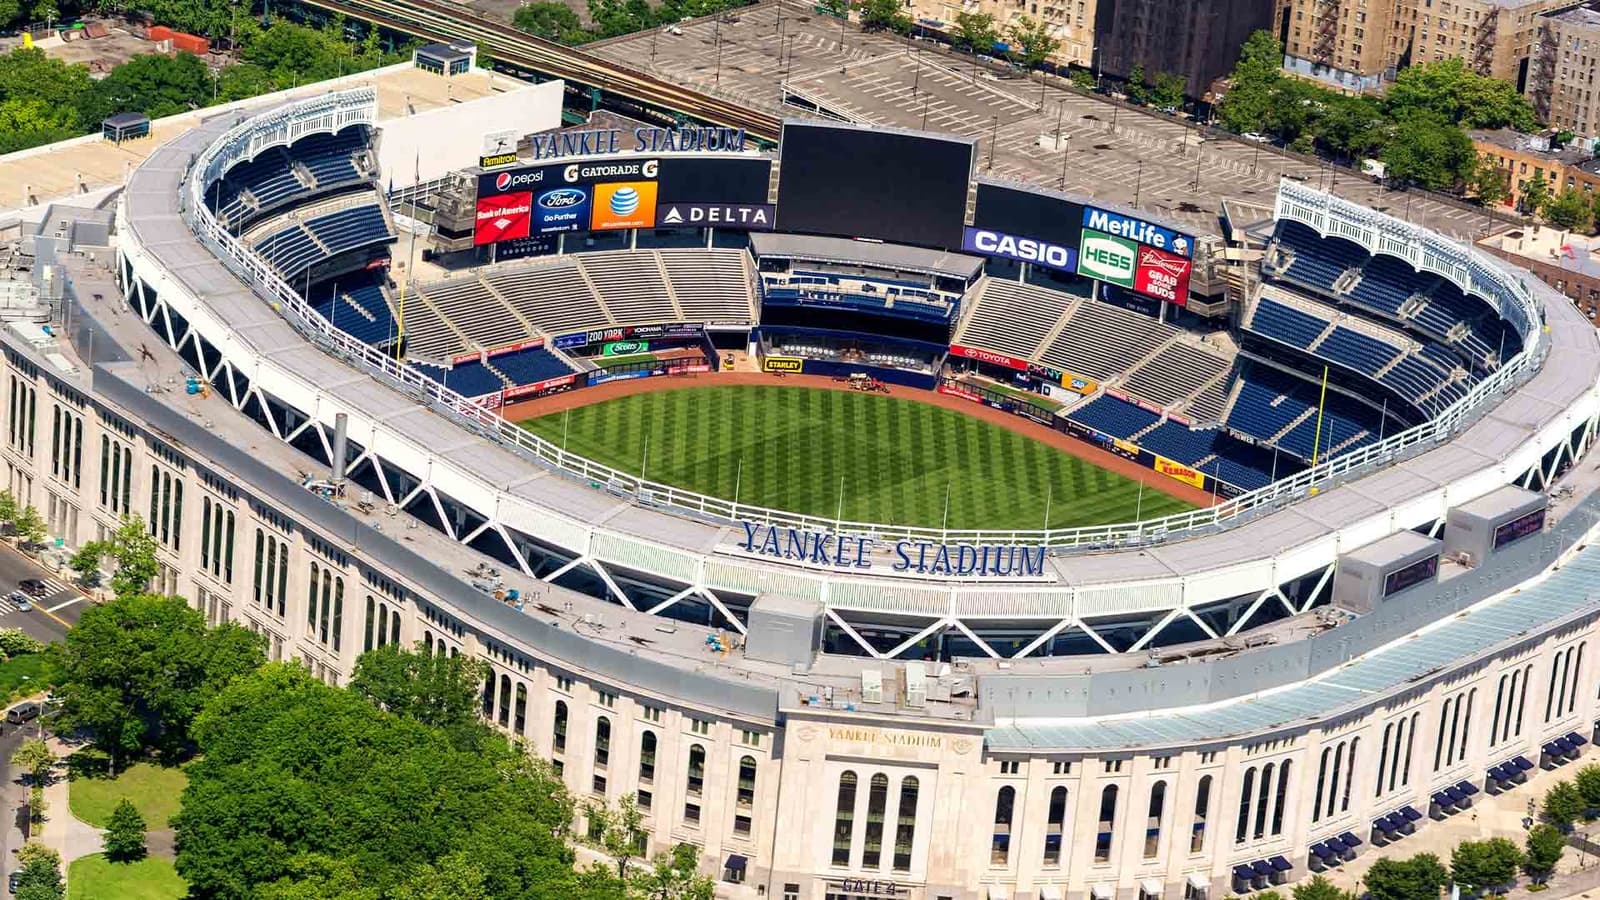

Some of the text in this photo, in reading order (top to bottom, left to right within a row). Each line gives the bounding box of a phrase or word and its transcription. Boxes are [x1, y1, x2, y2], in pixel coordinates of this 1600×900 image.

[532, 127, 746, 160] YANKEE STADIUM
[483, 154, 516, 166] Armitron
[512, 170, 544, 186] pepsi
[581, 164, 640, 178] GATORADE
[547, 192, 577, 206] Ford
[477, 205, 529, 220] Bank of America
[554, 213, 577, 221] Further
[690, 207, 767, 224] DELTA
[1088, 210, 1166, 248] MetLife
[974, 231, 1068, 267] CASIO
[1085, 245, 1132, 271] HESS
[1148, 270, 1177, 286] GRAB
[1147, 283, 1176, 300] BUDS
[588, 331, 603, 342] ZOO
[603, 328, 624, 340] YORK
[614, 341, 637, 352] Scotts
[768, 360, 800, 371] STANLEY
[978, 351, 1011, 366] TOYOTA
[1029, 364, 1062, 379] DKNY
[743, 521, 1047, 576] YANKEE STADIUM
[828, 728, 941, 748] YANKEE STADIUM
[842, 879, 896, 896] GATE 4
